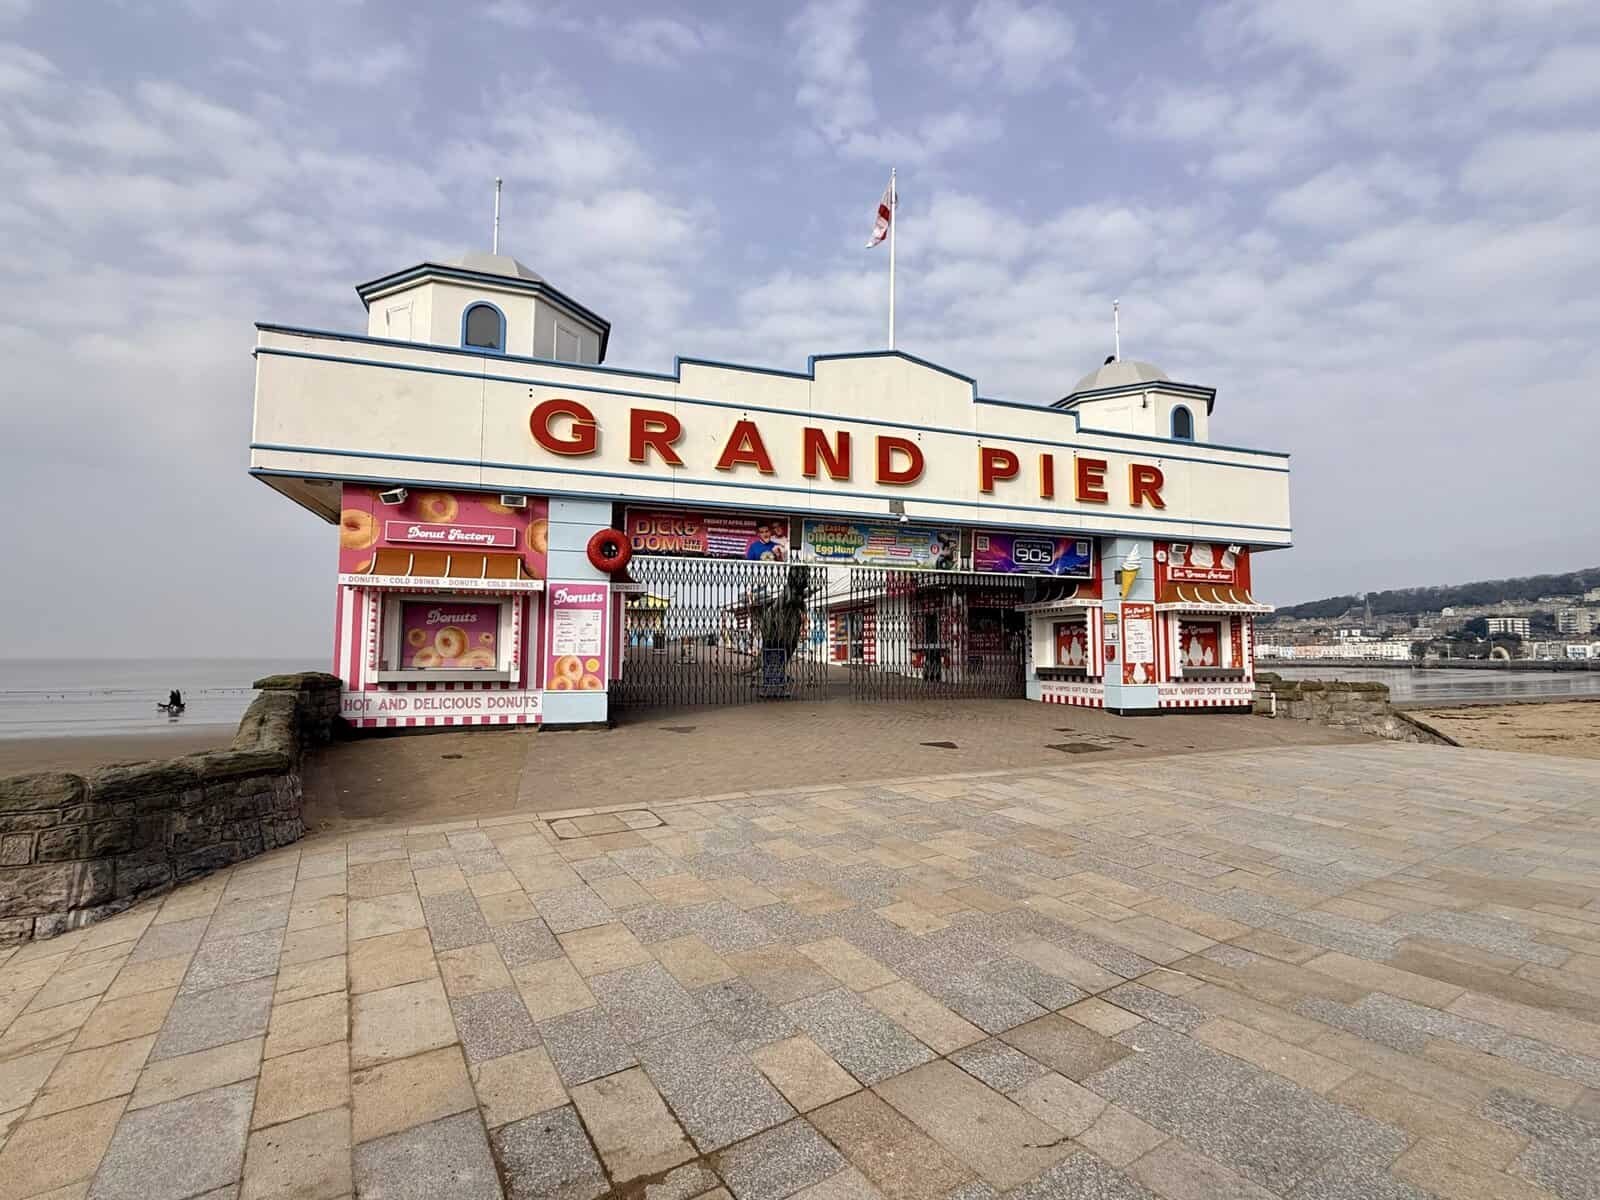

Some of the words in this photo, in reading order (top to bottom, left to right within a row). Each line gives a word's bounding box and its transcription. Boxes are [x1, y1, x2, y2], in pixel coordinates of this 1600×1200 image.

[529, 399, 924, 484] GRAND
[978, 446, 1166, 508] PIER
[408, 525, 445, 540] Donut
[447, 528, 495, 544] Factory
[636, 519, 682, 535] DICK
[631, 535, 681, 552] DOM
[807, 532, 865, 546] DINOSAUR
[815, 544, 833, 555] Egg
[834, 545, 855, 554] Hunt
[1016, 548, 1051, 562] 90s
[348, 576, 380, 584] DONUTS
[389, 577, 410, 585] COLD
[449, 579, 479, 587] DONUTS
[553, 587, 604, 606] Donuts
[426, 608, 479, 625] Donuts
[1207, 687, 1221, 695] SOFT
[343, 698, 373, 711] HOT
[378, 698, 408, 711] AND
[414, 697, 482, 710] DELICIOUS
[487, 696, 539, 709] DONUTS
